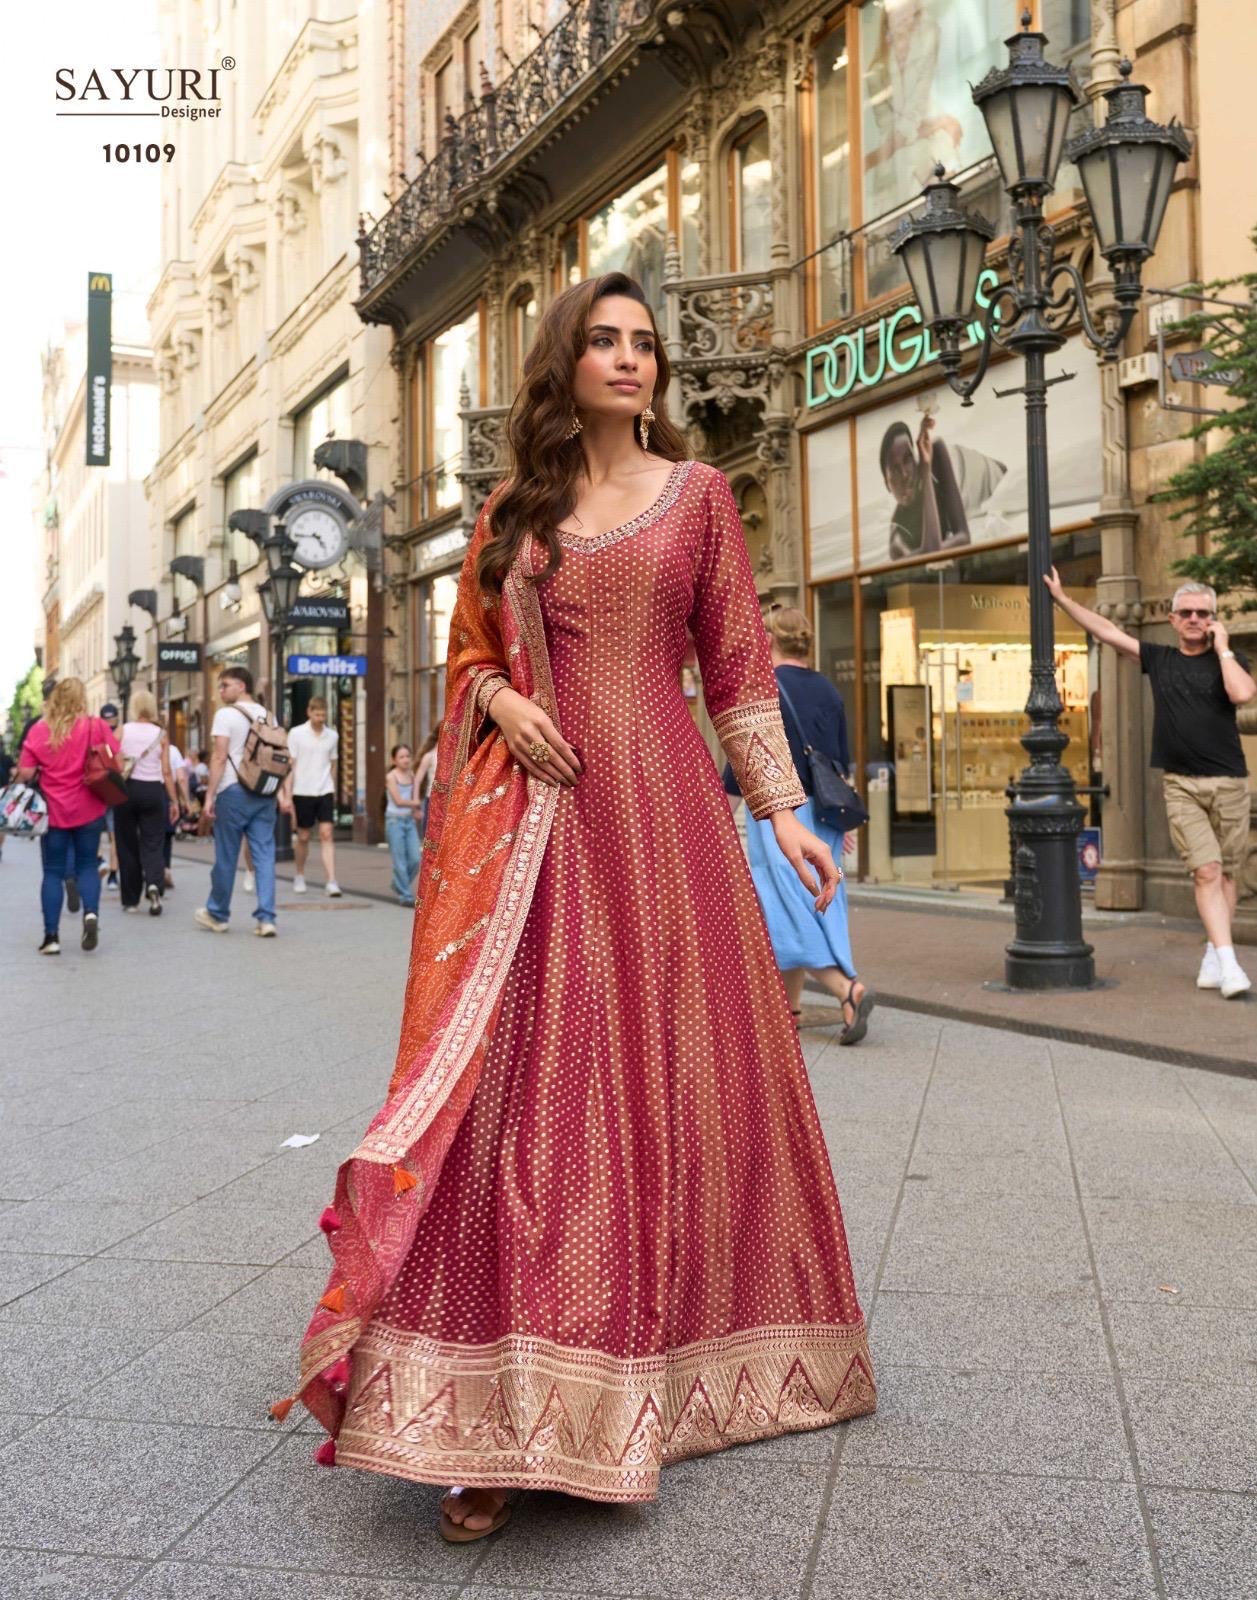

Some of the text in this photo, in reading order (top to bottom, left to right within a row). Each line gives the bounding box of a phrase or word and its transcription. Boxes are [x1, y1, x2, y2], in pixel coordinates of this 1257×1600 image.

[806, 268, 1002, 408] DOUGLS
[91, 375, 107, 457] McDonald's
[969, 594, 1021, 609] Maison
[160, 650, 198, 661] OFFICE
[297, 657, 358, 675] Berlitz
